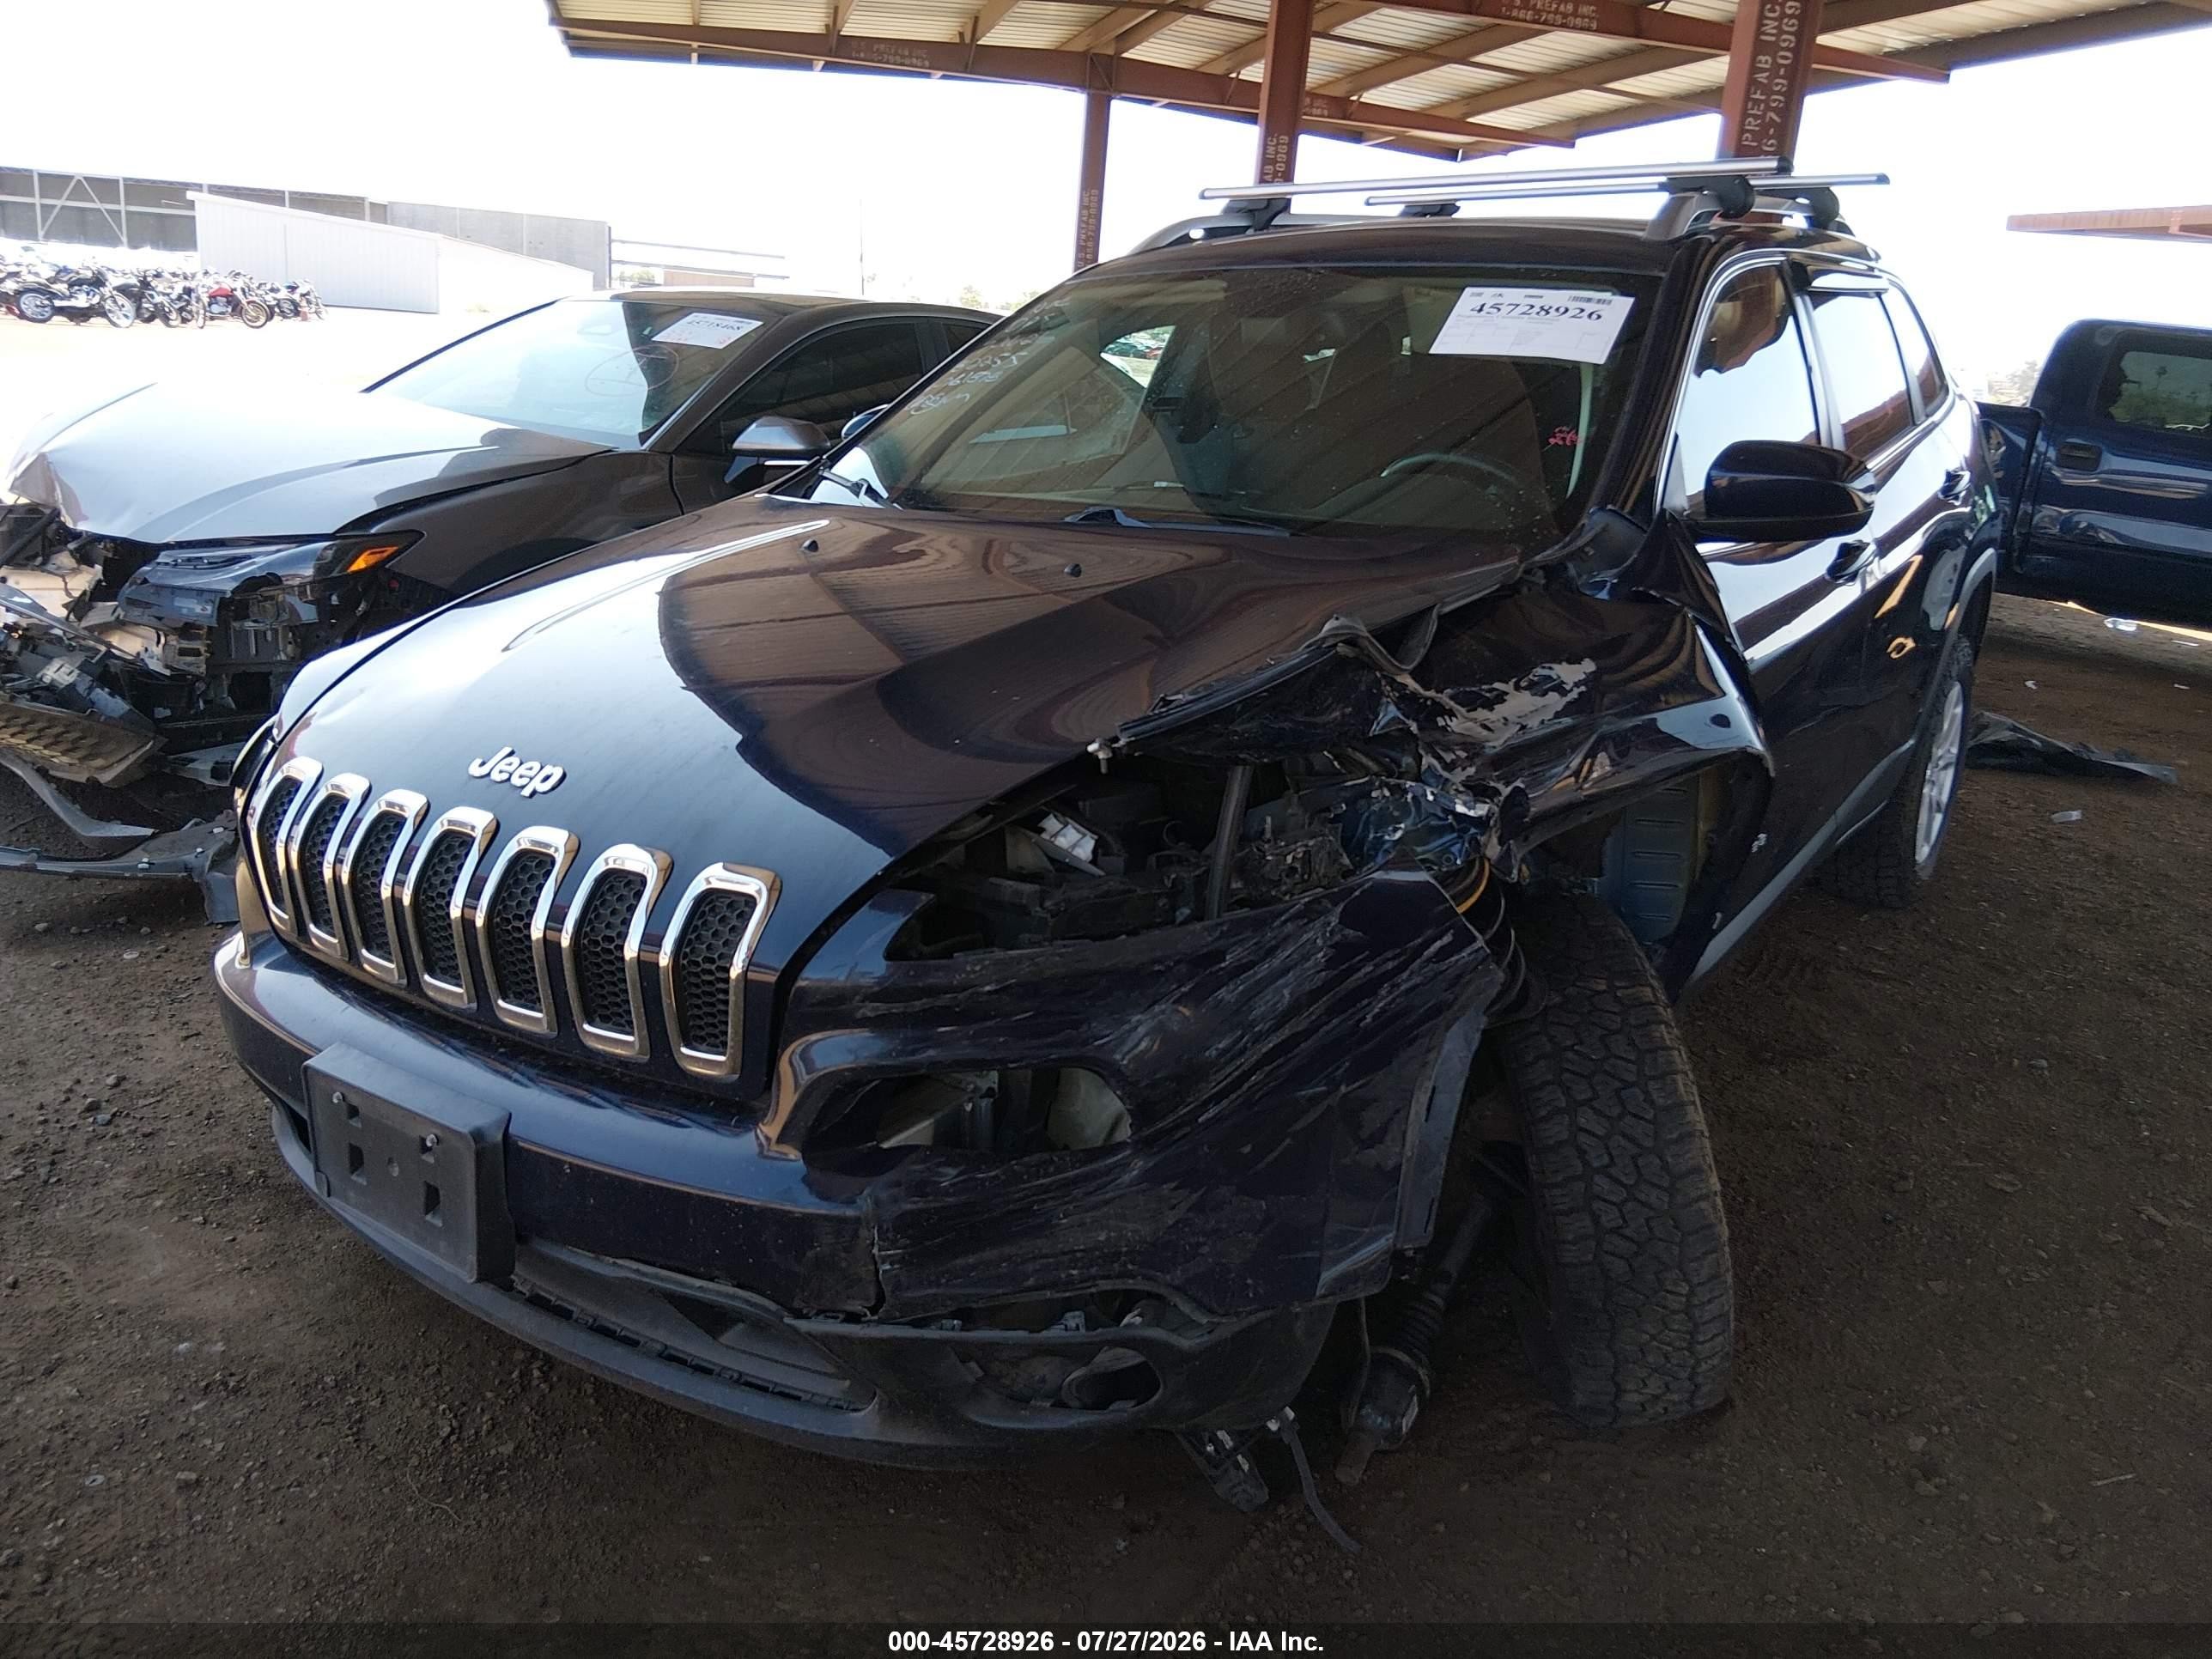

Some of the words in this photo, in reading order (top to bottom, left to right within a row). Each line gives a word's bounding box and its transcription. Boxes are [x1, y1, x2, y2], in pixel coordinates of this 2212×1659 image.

[1741, 54, 1773, 147] PREFAB
[1760, 1, 1802, 158] 6-799-0969
[1265, 132, 1278, 159] INC.
[1469, 302, 1604, 322] 45728926
[468, 746, 567, 798] Jeep
